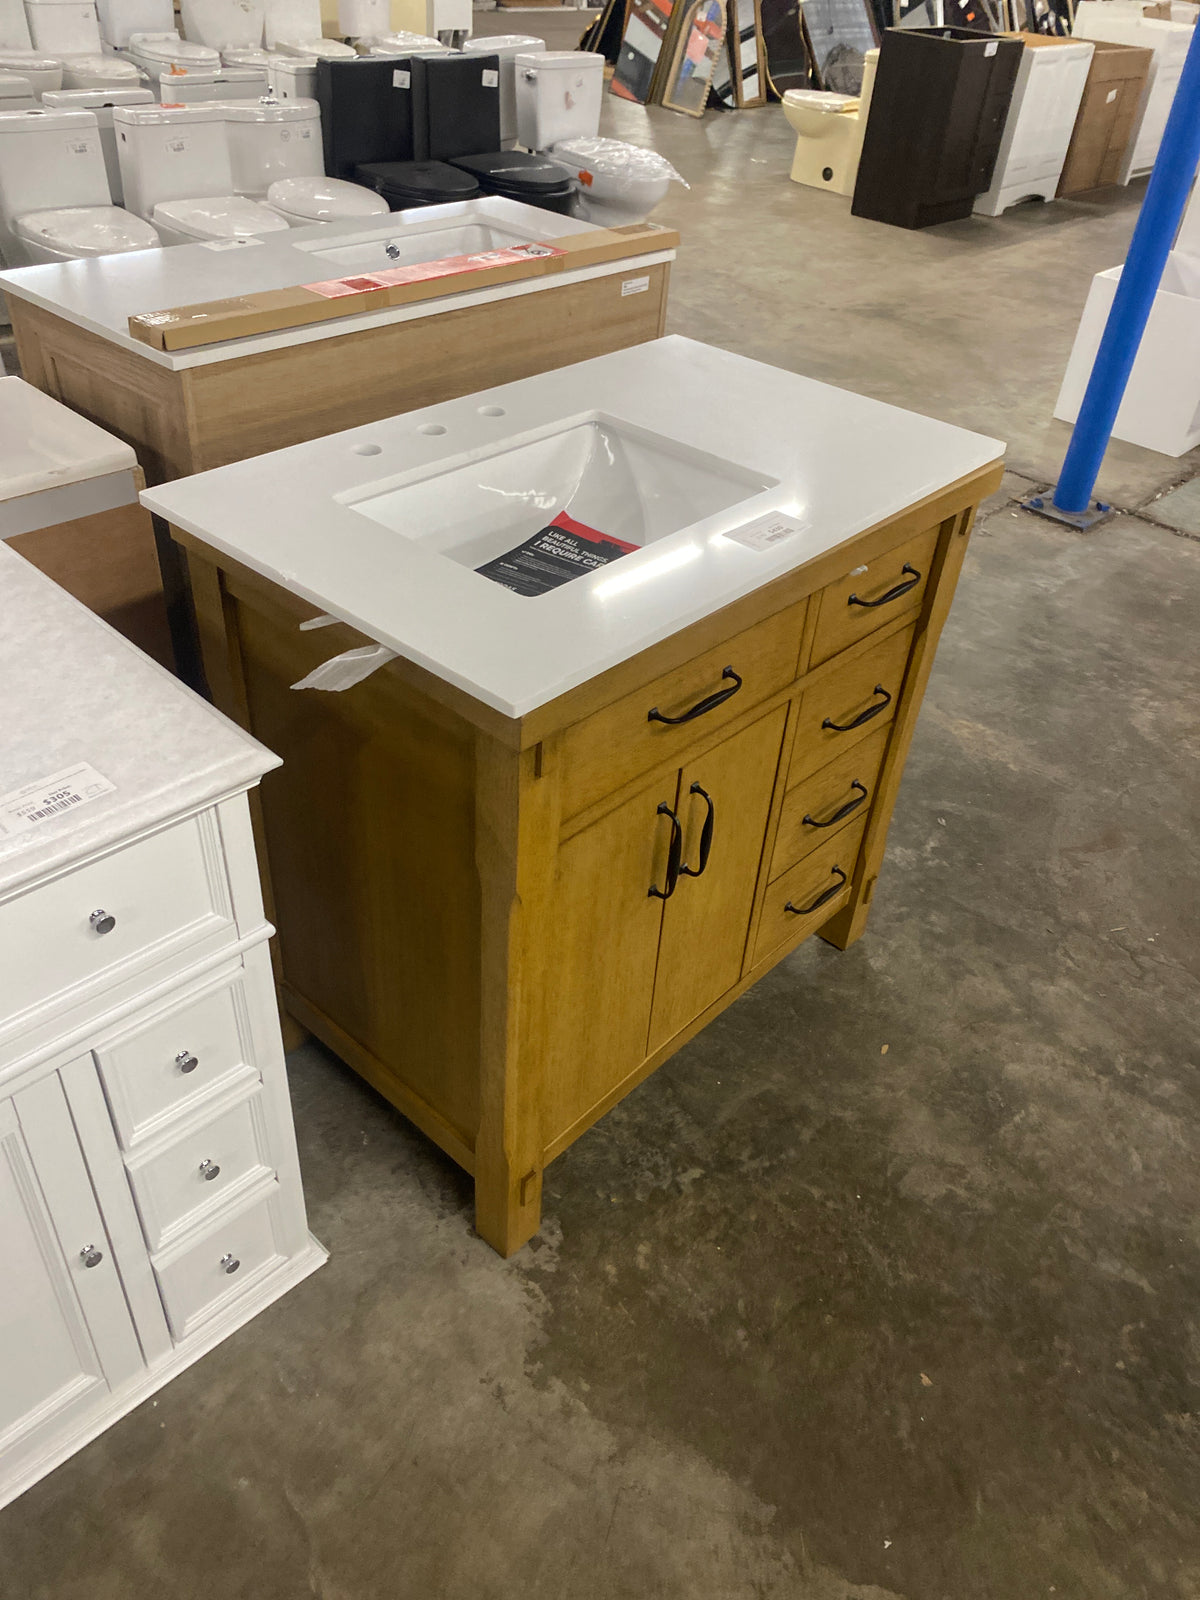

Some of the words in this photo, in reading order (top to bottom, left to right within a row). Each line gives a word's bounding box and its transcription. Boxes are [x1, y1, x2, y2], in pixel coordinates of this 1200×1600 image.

[548, 531, 566, 540] LIKE
[540, 542, 584, 561] REQUIRE
[542, 536, 580, 553] BEAUTIFUL
[43, 791, 71, 806] $305
